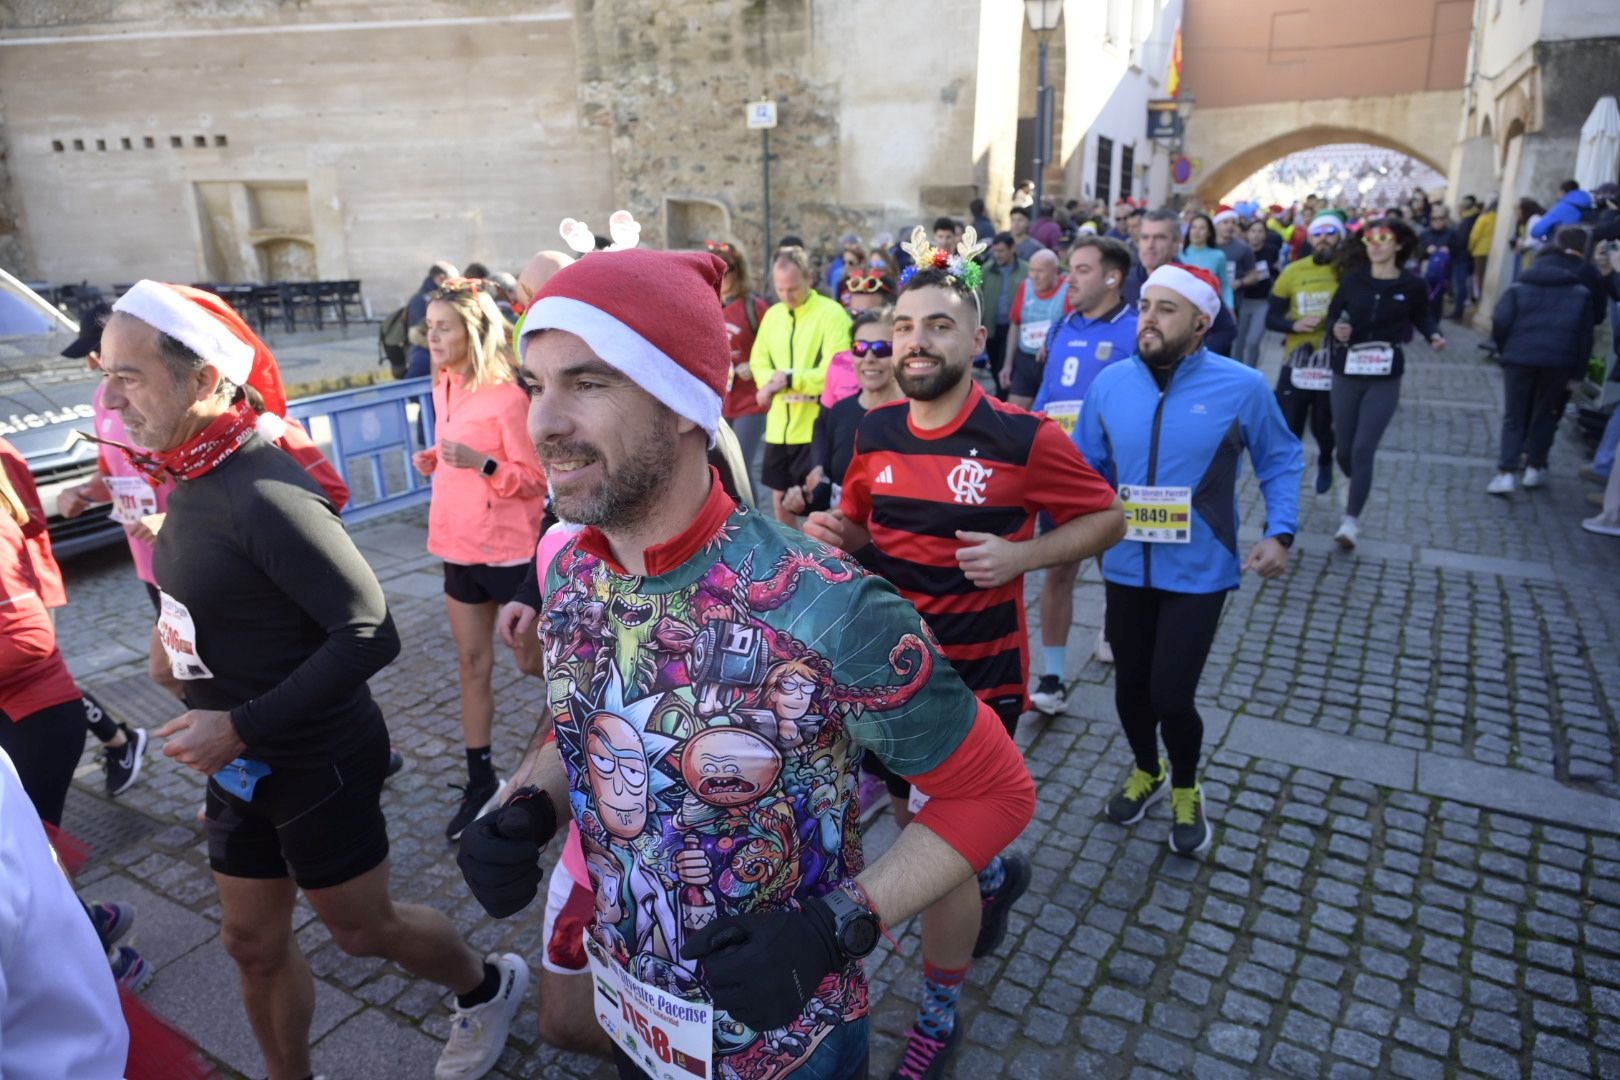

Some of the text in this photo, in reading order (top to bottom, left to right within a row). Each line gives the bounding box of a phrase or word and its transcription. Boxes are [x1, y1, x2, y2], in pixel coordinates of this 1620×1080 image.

[1061, 356, 1080, 387] 9
[1134, 507, 1168, 523] 1849
[657, 992, 707, 1025] Pacense
[617, 990, 672, 1064] 1158
